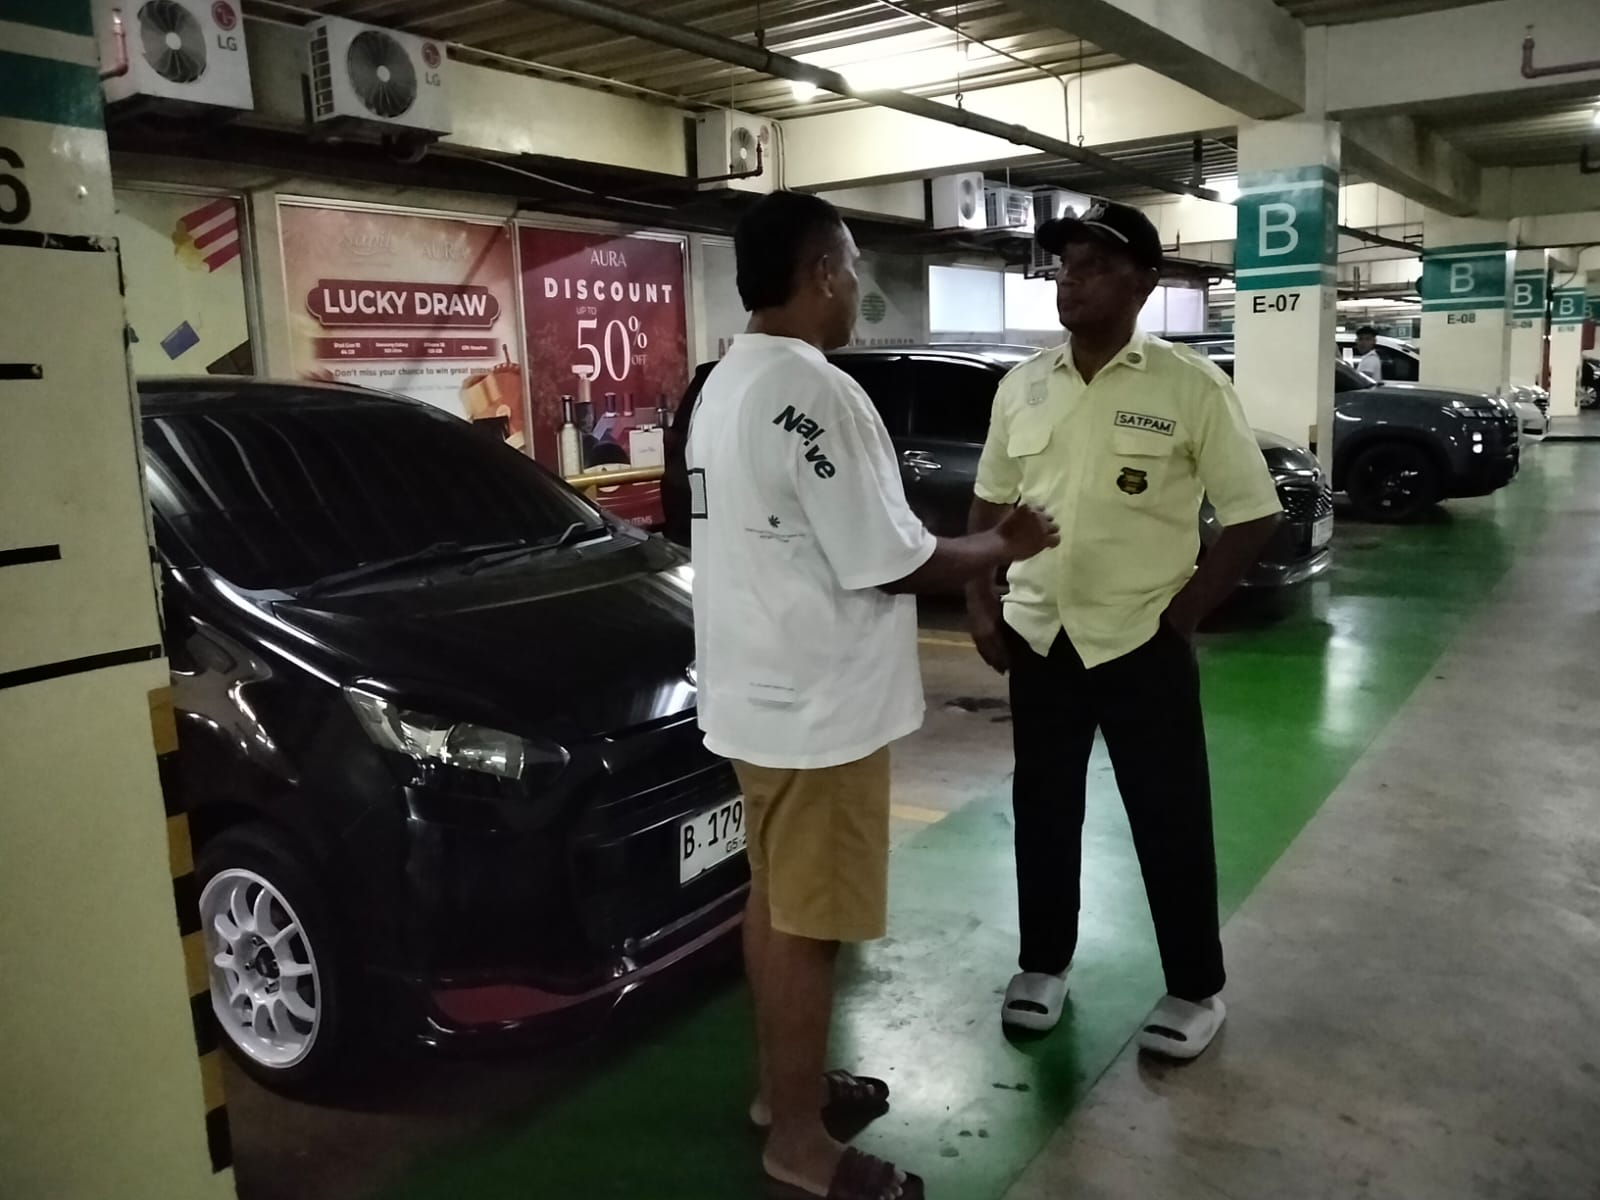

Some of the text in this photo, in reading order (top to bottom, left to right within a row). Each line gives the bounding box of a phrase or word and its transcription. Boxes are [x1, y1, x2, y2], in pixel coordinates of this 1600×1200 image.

[217, 34, 238, 51] LG
[425, 71, 441, 87] LG
[1258, 202, 1299, 257] B
[590, 249, 628, 268] AURA
[1450, 263, 1475, 293] B
[544, 277, 672, 303] DISCOUNT
[1514, 283, 1533, 306] B
[323, 288, 487, 317] LUCKY DRAW
[576, 306, 598, 315] UP TO
[1253, 293, 1301, 313] E-07
[1560, 298, 1574, 315] B
[1447, 313, 1476, 325] E-08
[577, 315, 648, 382] 50%
[631, 354, 648, 366] OFF
[334, 368, 356, 377] Don't
[380, 369, 396, 377] your
[426, 367, 434, 375] to
[436, 367, 449, 375] win
[1119, 414, 1172, 433] SATPAM
